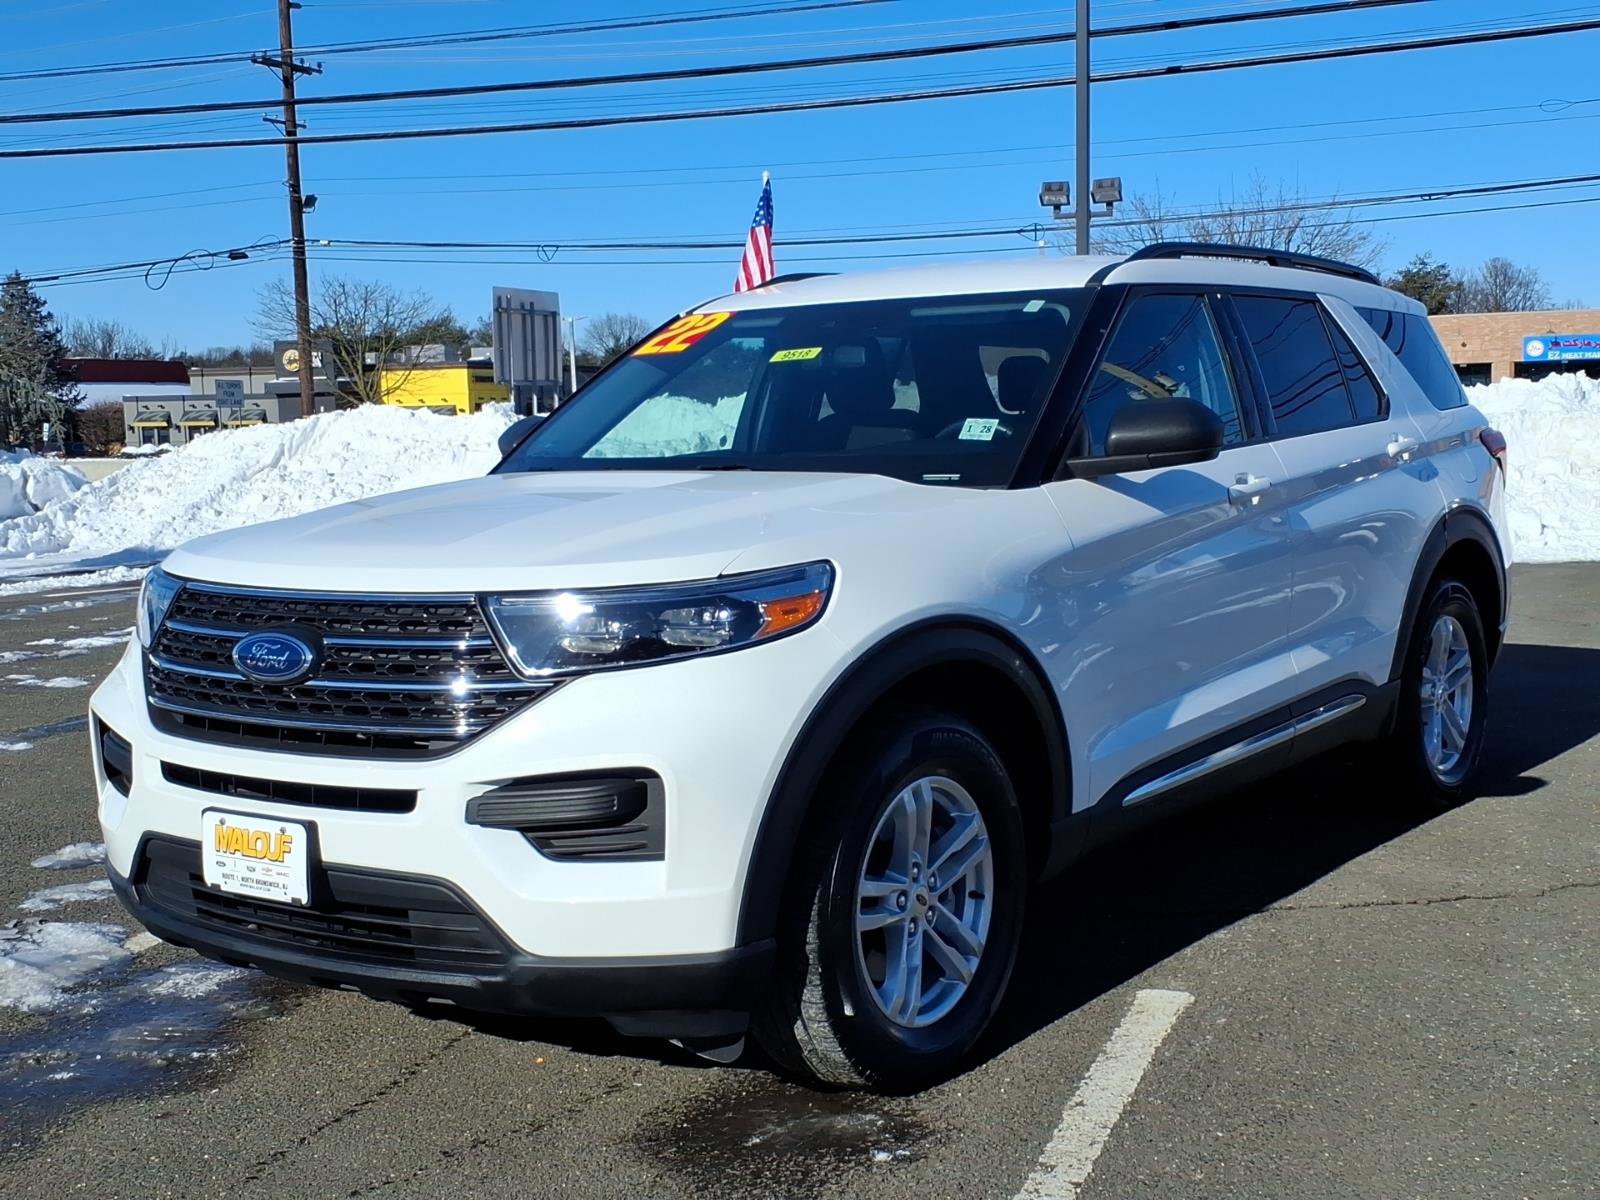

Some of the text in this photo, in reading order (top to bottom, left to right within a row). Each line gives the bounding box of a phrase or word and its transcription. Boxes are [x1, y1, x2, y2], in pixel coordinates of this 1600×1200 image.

[631, 312, 731, 356] 22
[782, 350, 812, 360] 9518
[1548, 351, 1560, 360] EZ
[1562, 351, 1584, 360] MEAT
[980, 425, 992, 433] 28
[247, 642, 290, 669] Ford
[215, 824, 292, 863] MALOUF
[222, 872, 235, 880] ROUTE
